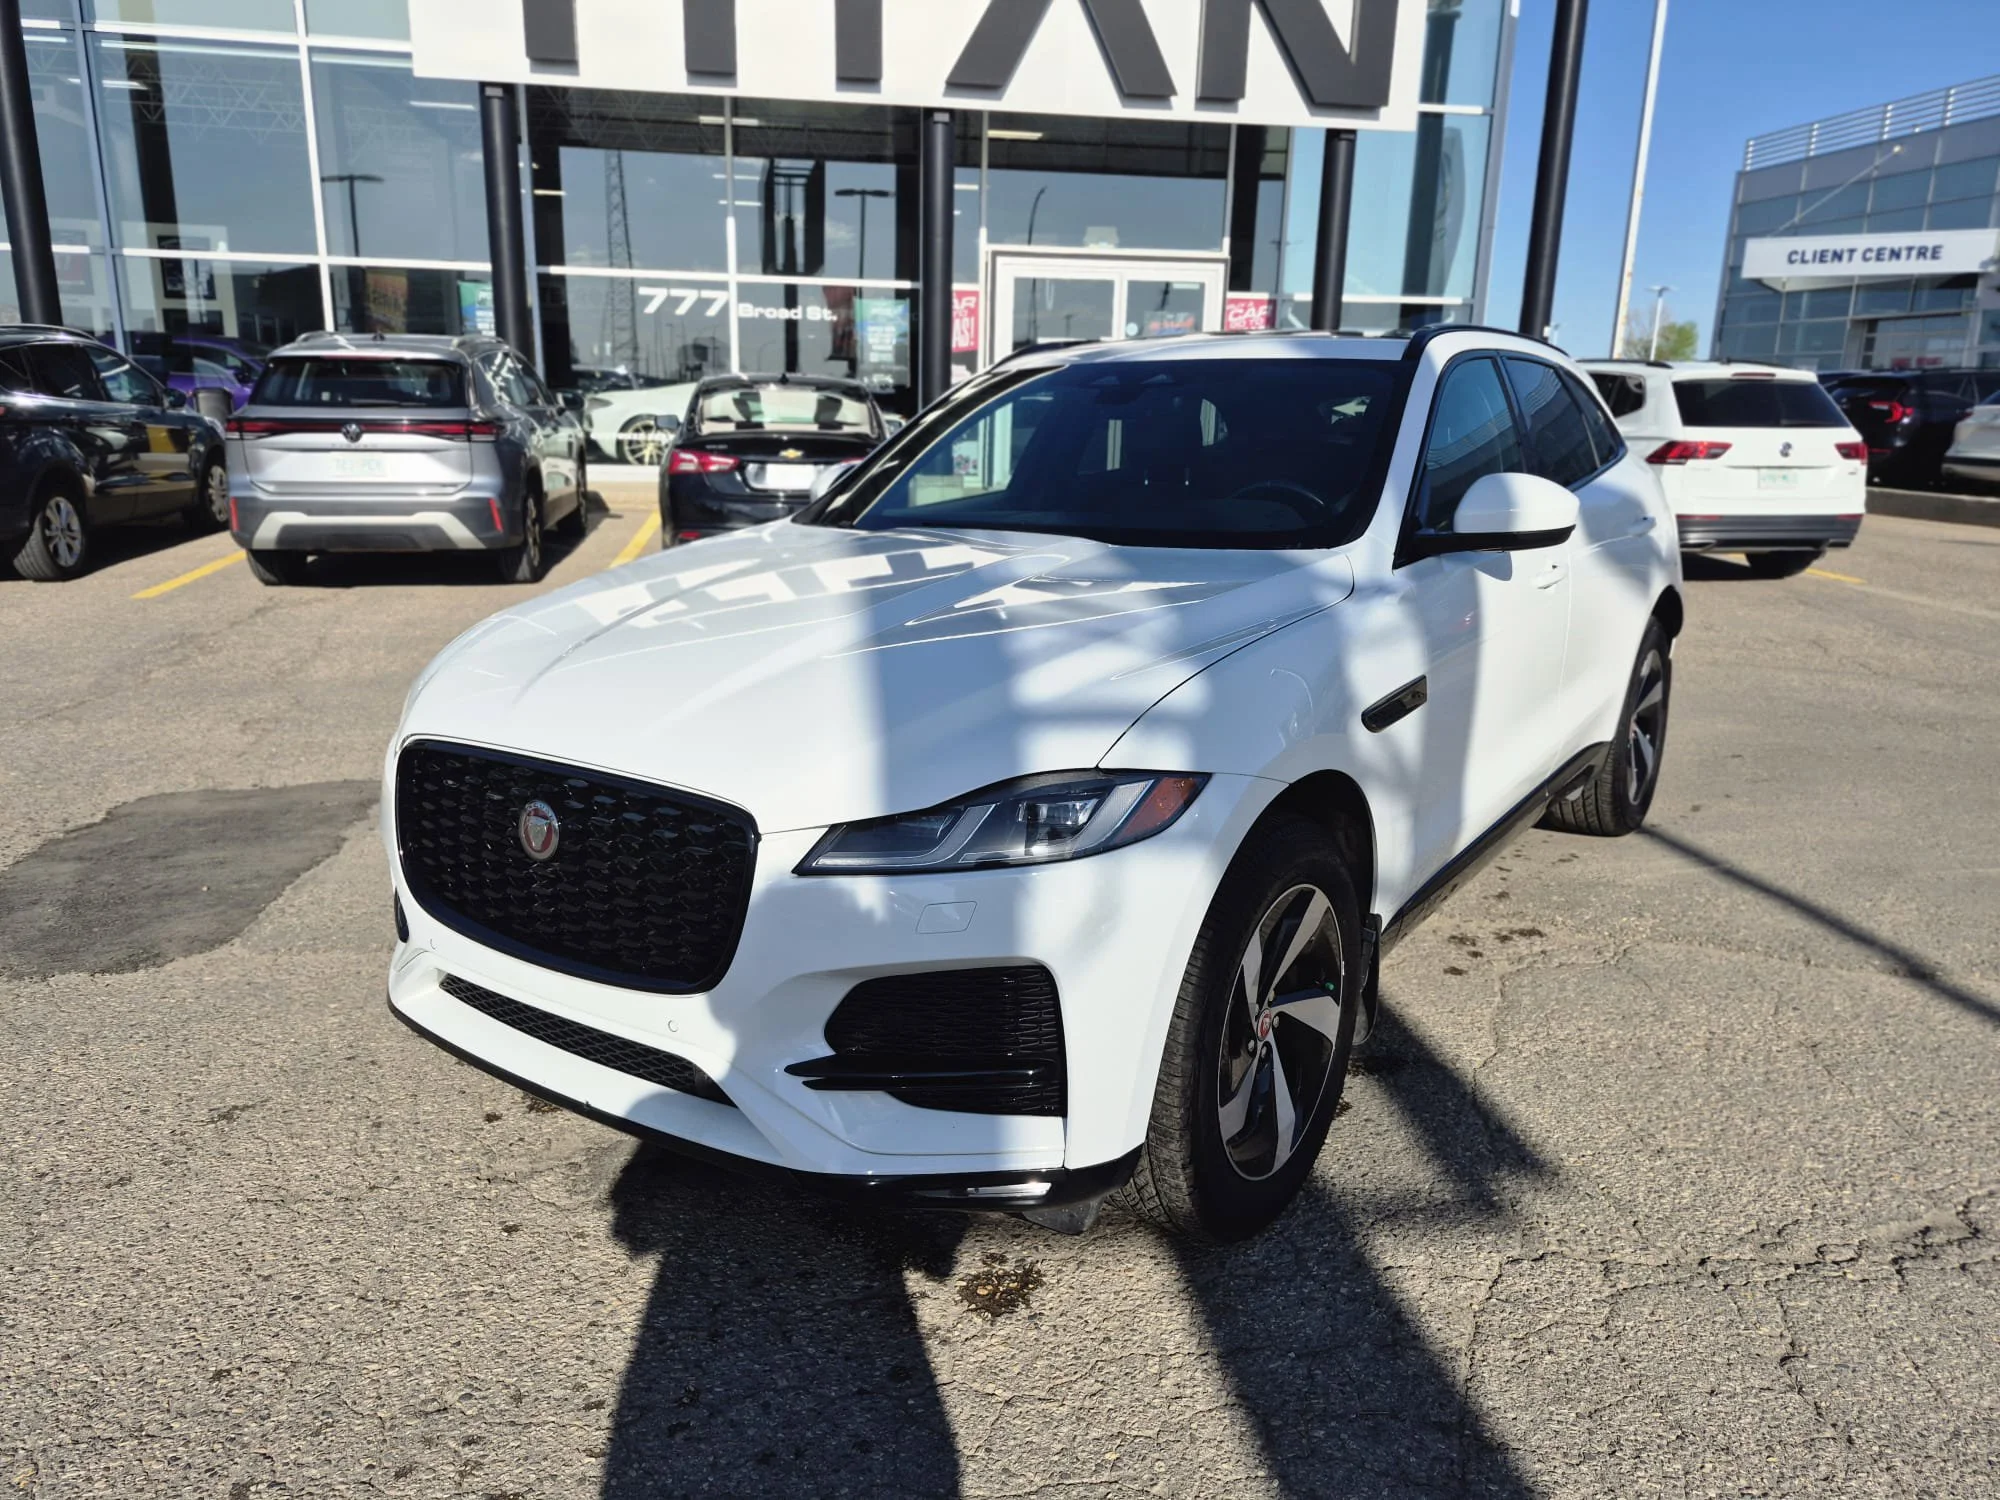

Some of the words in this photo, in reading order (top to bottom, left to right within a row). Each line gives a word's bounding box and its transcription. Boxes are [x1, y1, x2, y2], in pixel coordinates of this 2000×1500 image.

[1786, 248, 1857, 265] CLIENT
[1861, 244, 1944, 262] CENTRE
[638, 286, 729, 317] 777
[738, 303, 802, 319] Broad
[806, 305, 838, 321] St.
